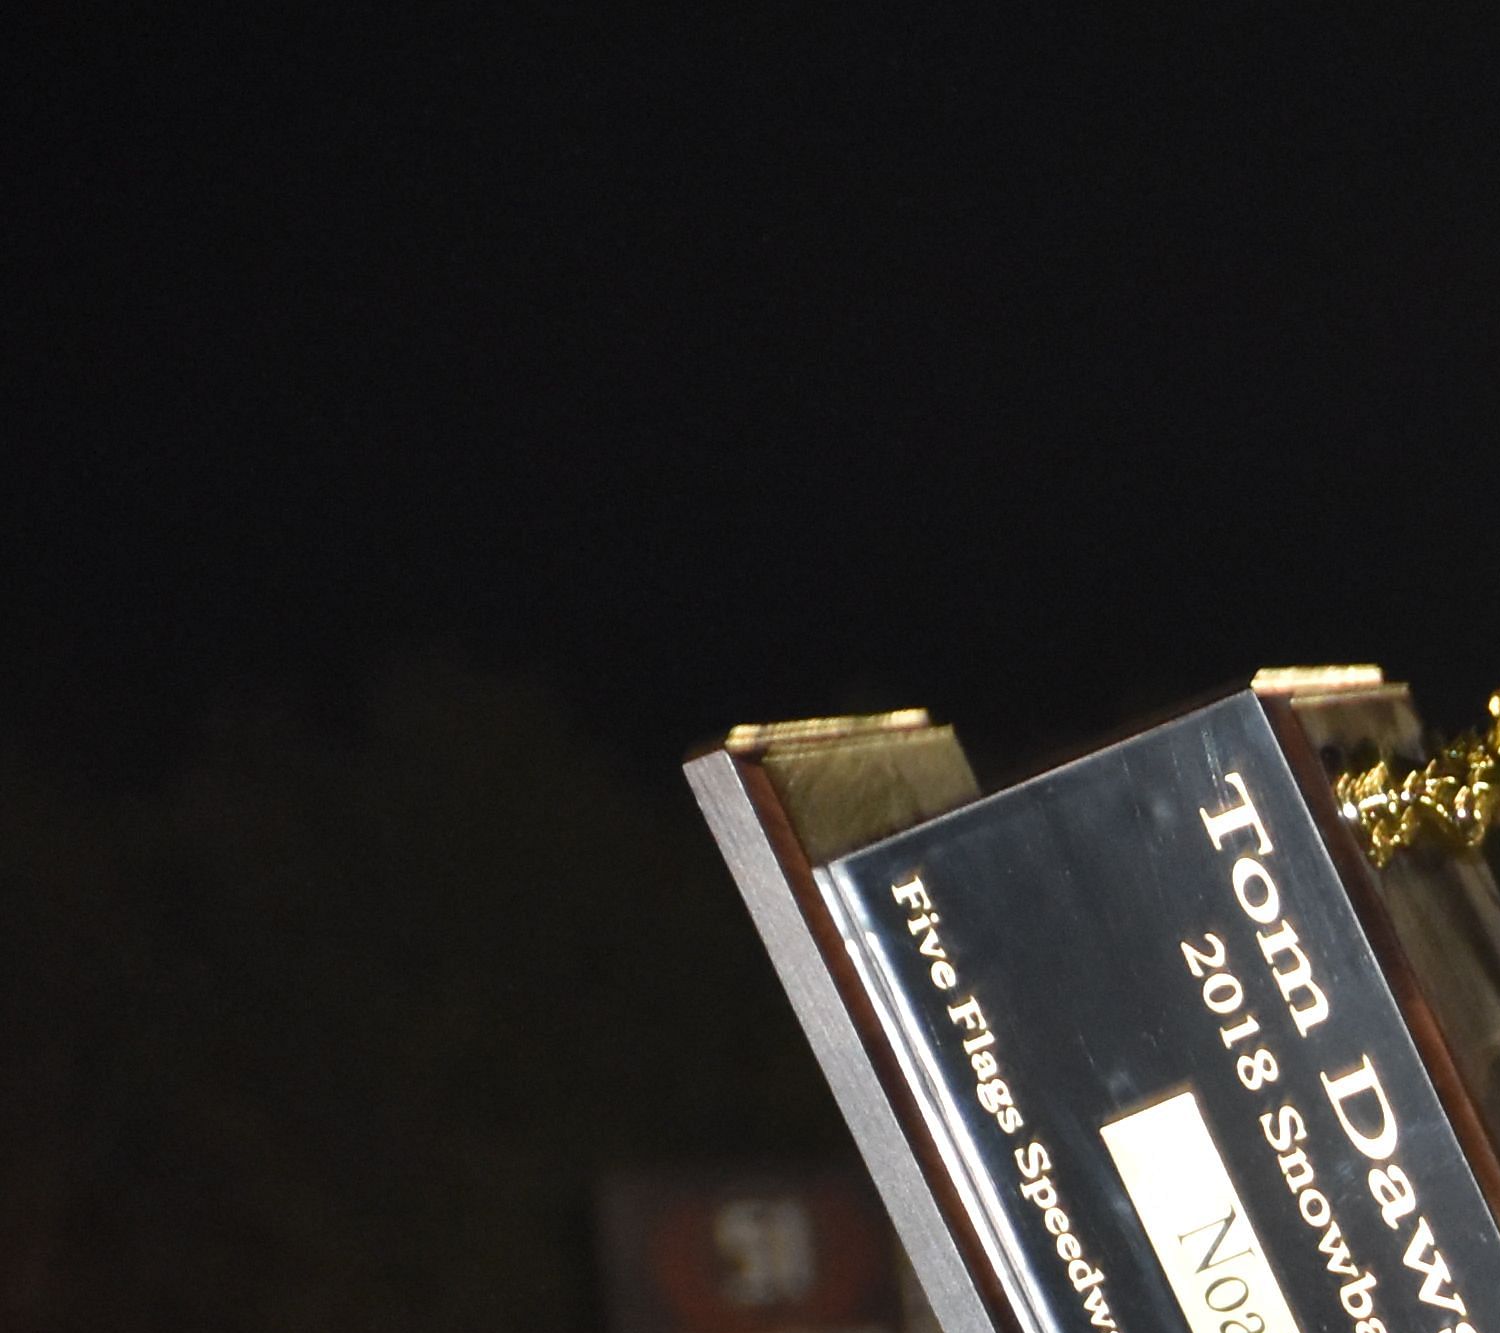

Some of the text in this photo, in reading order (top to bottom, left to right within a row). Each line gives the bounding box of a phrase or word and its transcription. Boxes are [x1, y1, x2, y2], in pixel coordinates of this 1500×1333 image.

[892, 875, 956, 990] Five
[948, 996, 1024, 1134] Flags
[1181, 932, 1279, 1091] 2018
[1200, 772, 1329, 1037] Tom
